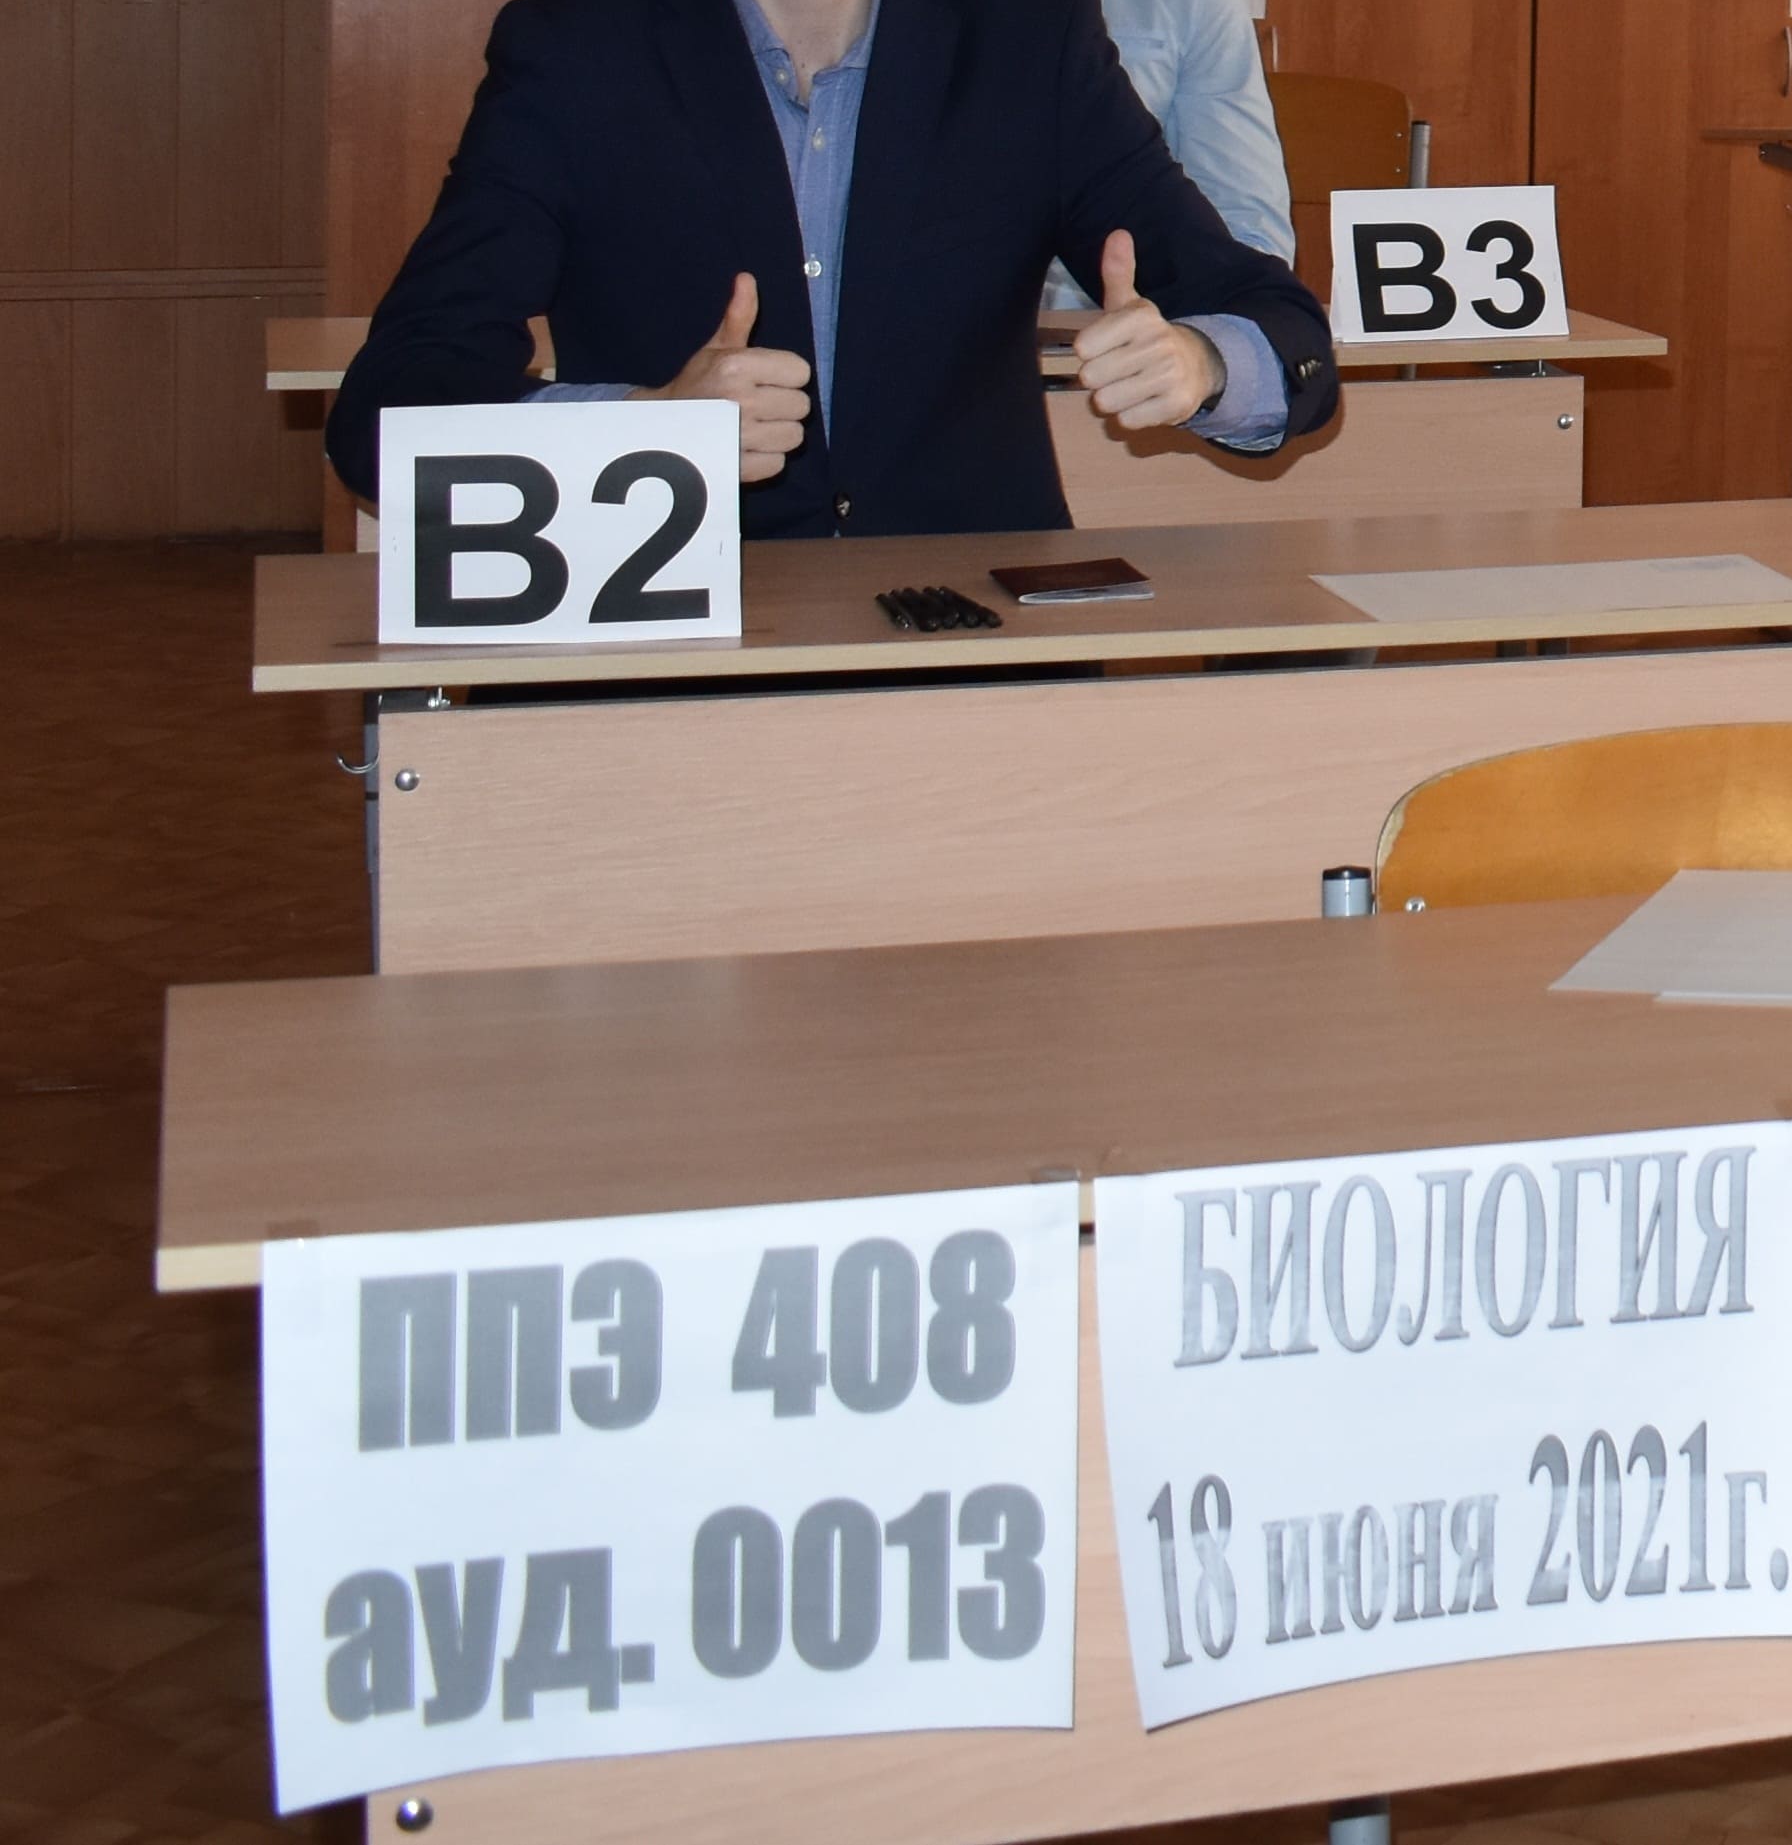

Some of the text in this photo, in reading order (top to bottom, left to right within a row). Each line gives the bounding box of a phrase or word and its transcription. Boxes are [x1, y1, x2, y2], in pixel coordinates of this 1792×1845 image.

[1352, 219, 1547, 333] В3
[413, 449, 711, 628] В2
[358, 1228, 1016, 1453] ППЭ 408
[1173, 1145, 1757, 1368] БИОЛОГИЯ
[324, 1483, 1046, 1727] ауд. 0013
[1147, 1420, 1790, 1669] 18 июня 2021г.
